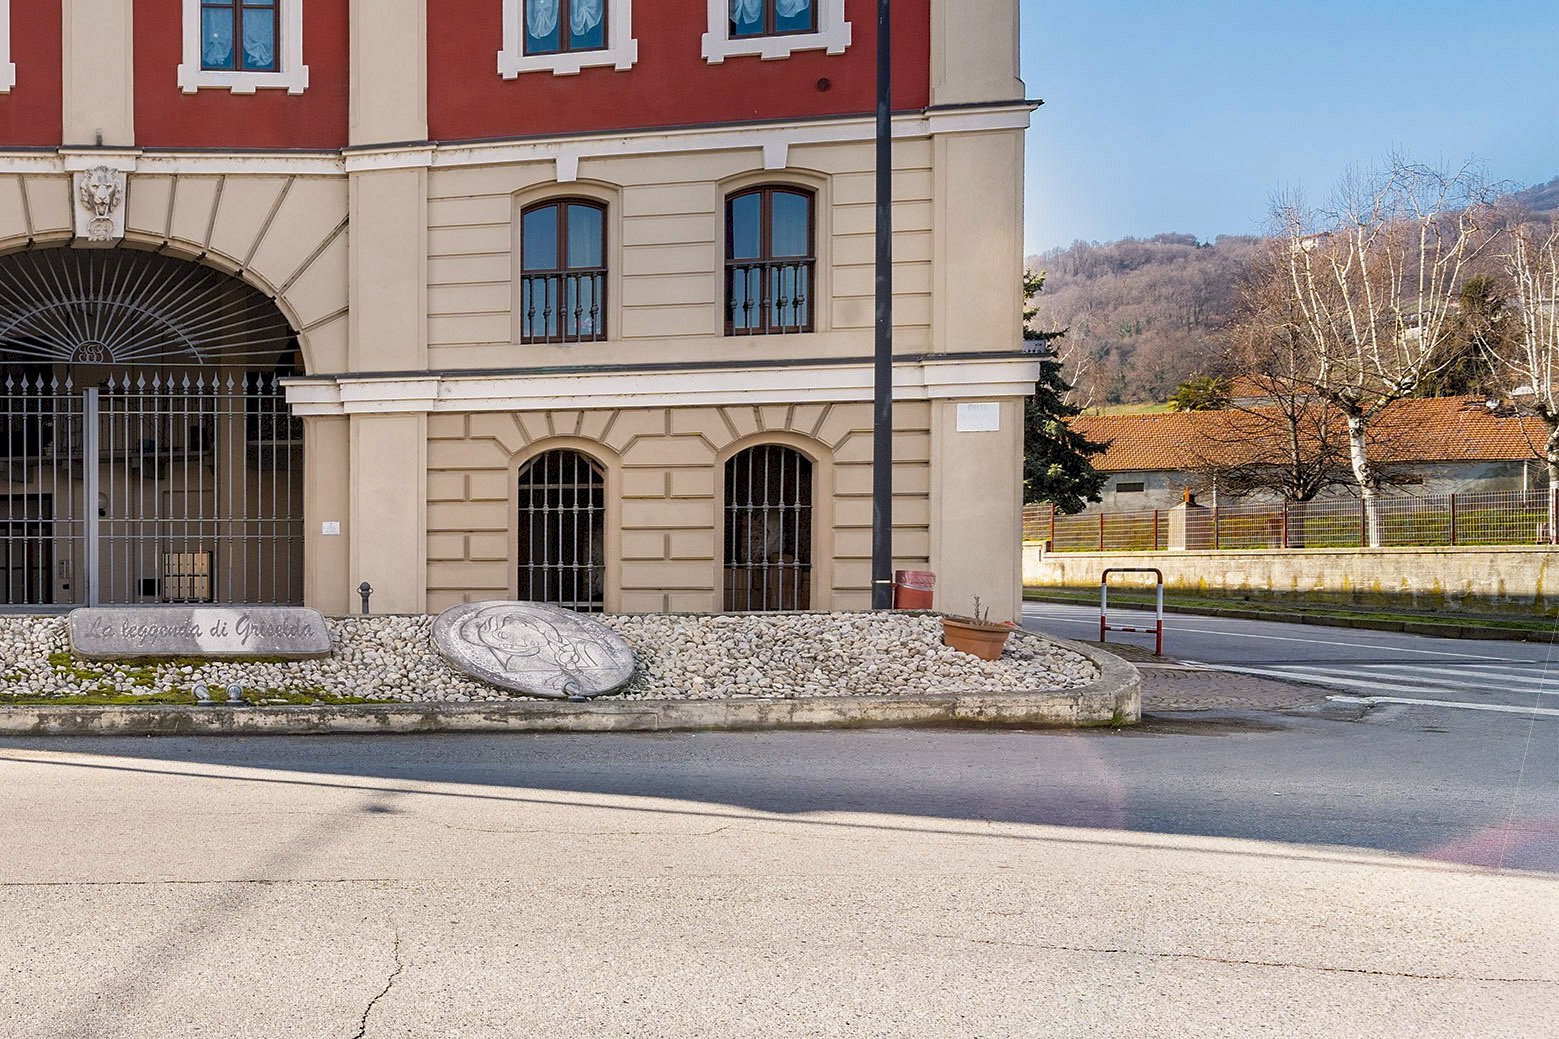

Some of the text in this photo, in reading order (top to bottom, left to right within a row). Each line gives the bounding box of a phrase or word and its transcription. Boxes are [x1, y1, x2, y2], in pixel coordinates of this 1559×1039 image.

[85, 613, 315, 646] La leggenda di Griselda
